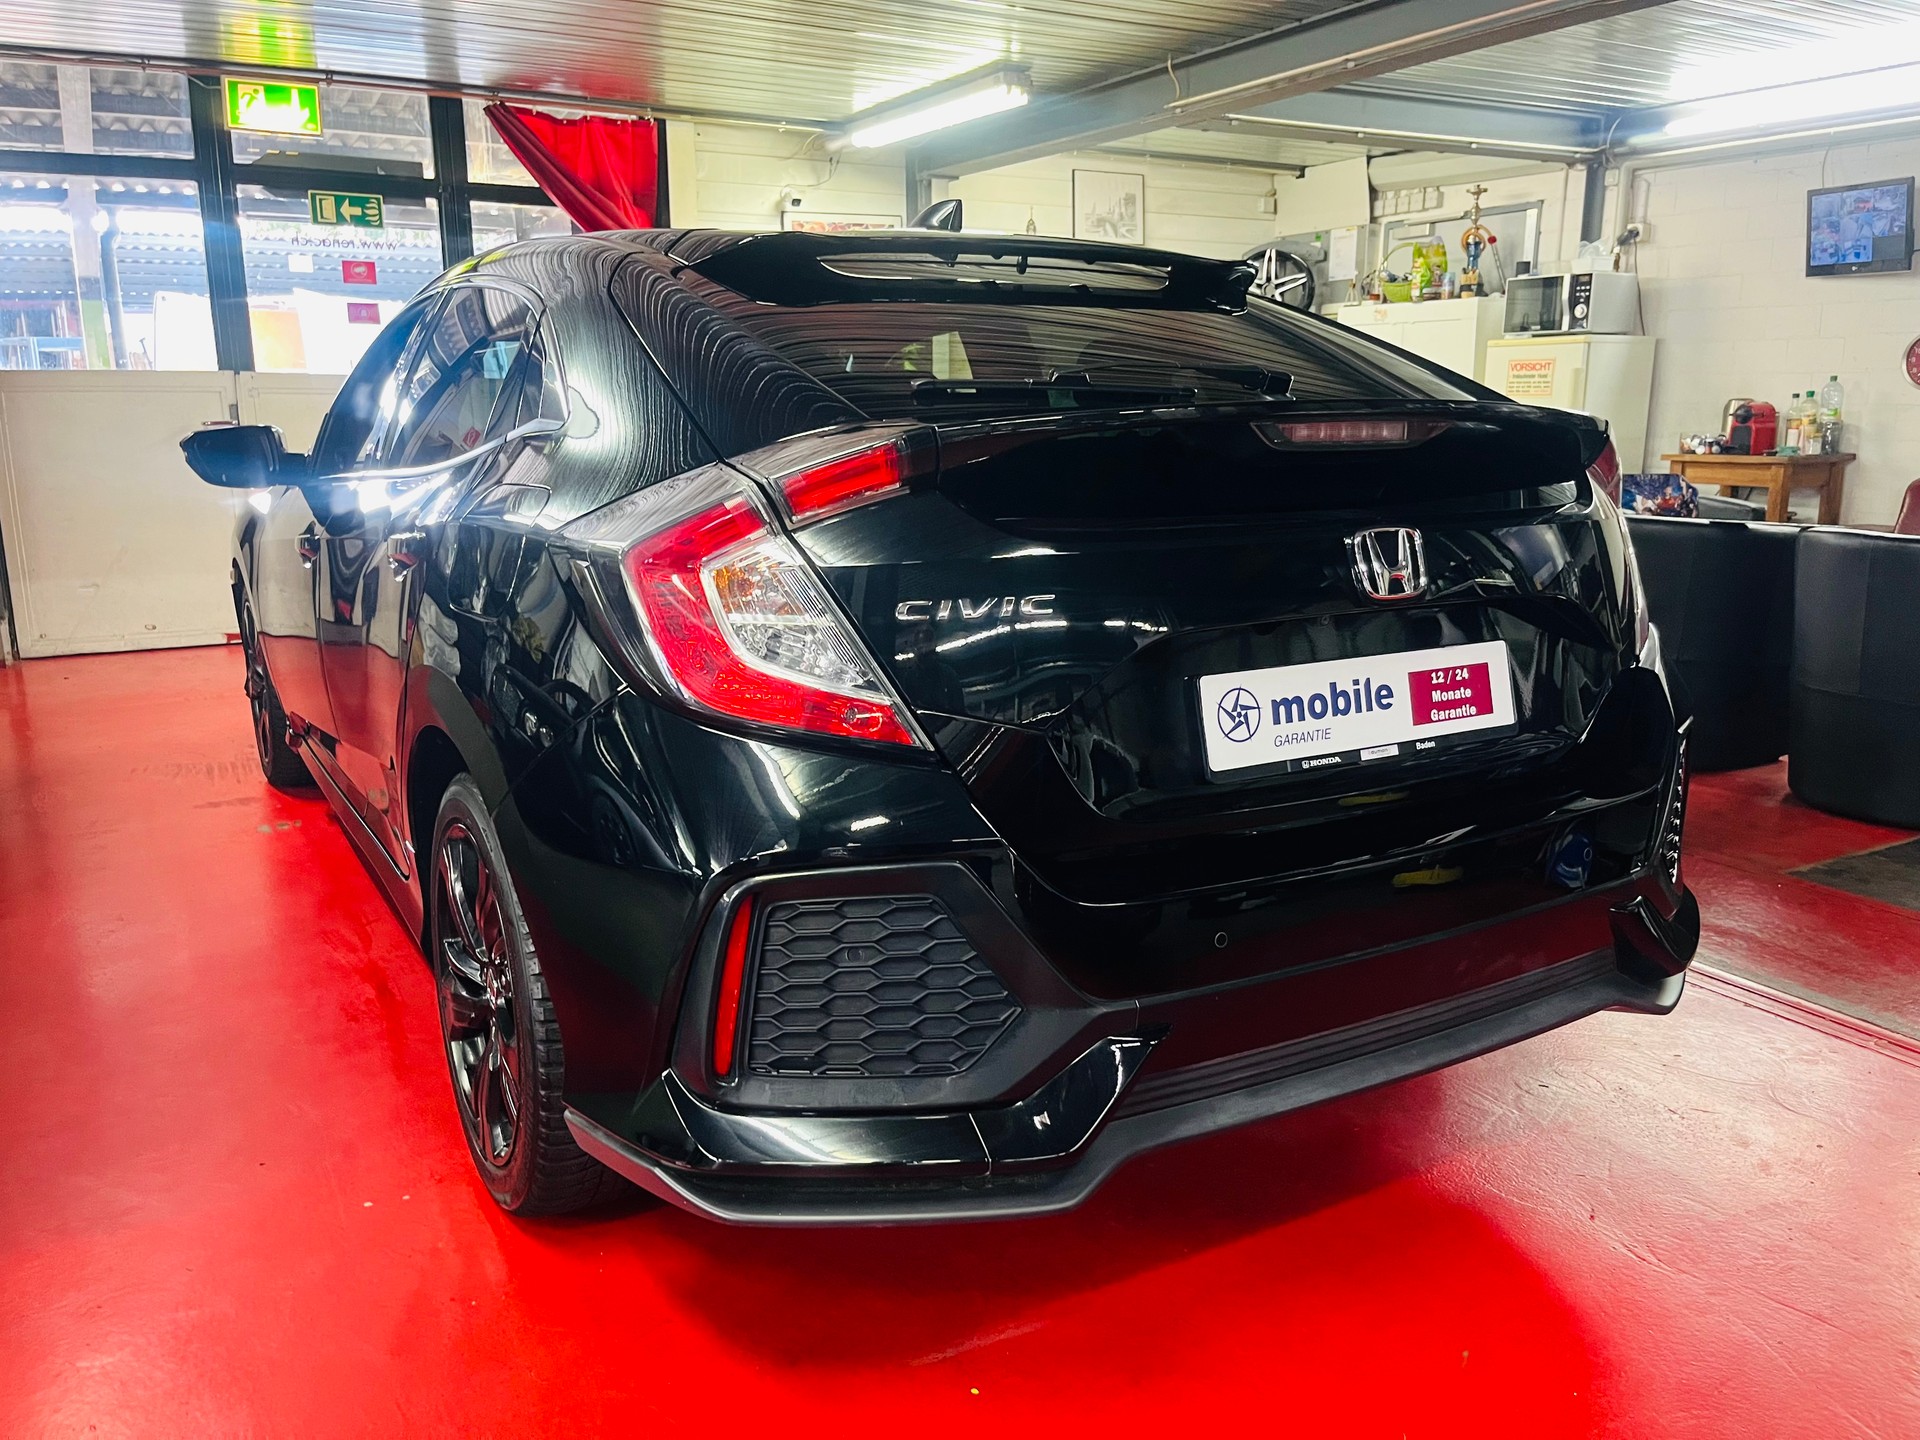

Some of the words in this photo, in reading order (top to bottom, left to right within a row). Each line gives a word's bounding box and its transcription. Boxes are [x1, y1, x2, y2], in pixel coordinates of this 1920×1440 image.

[1510, 363, 1552, 371] VORSICHT
[896, 594, 1055, 621] CIVIC
[1431, 671, 1444, 684] 12
[1446, 670, 1452, 684] /
[1455, 668, 1469, 681] 24
[1271, 677, 1394, 726] mobile
[1431, 687, 1472, 702] Monate
[1431, 704, 1477, 721] Garantie
[1274, 728, 1332, 747] GARANTIE
[1309, 755, 1342, 767] HONDA
[1415, 740, 1436, 750] Baden
